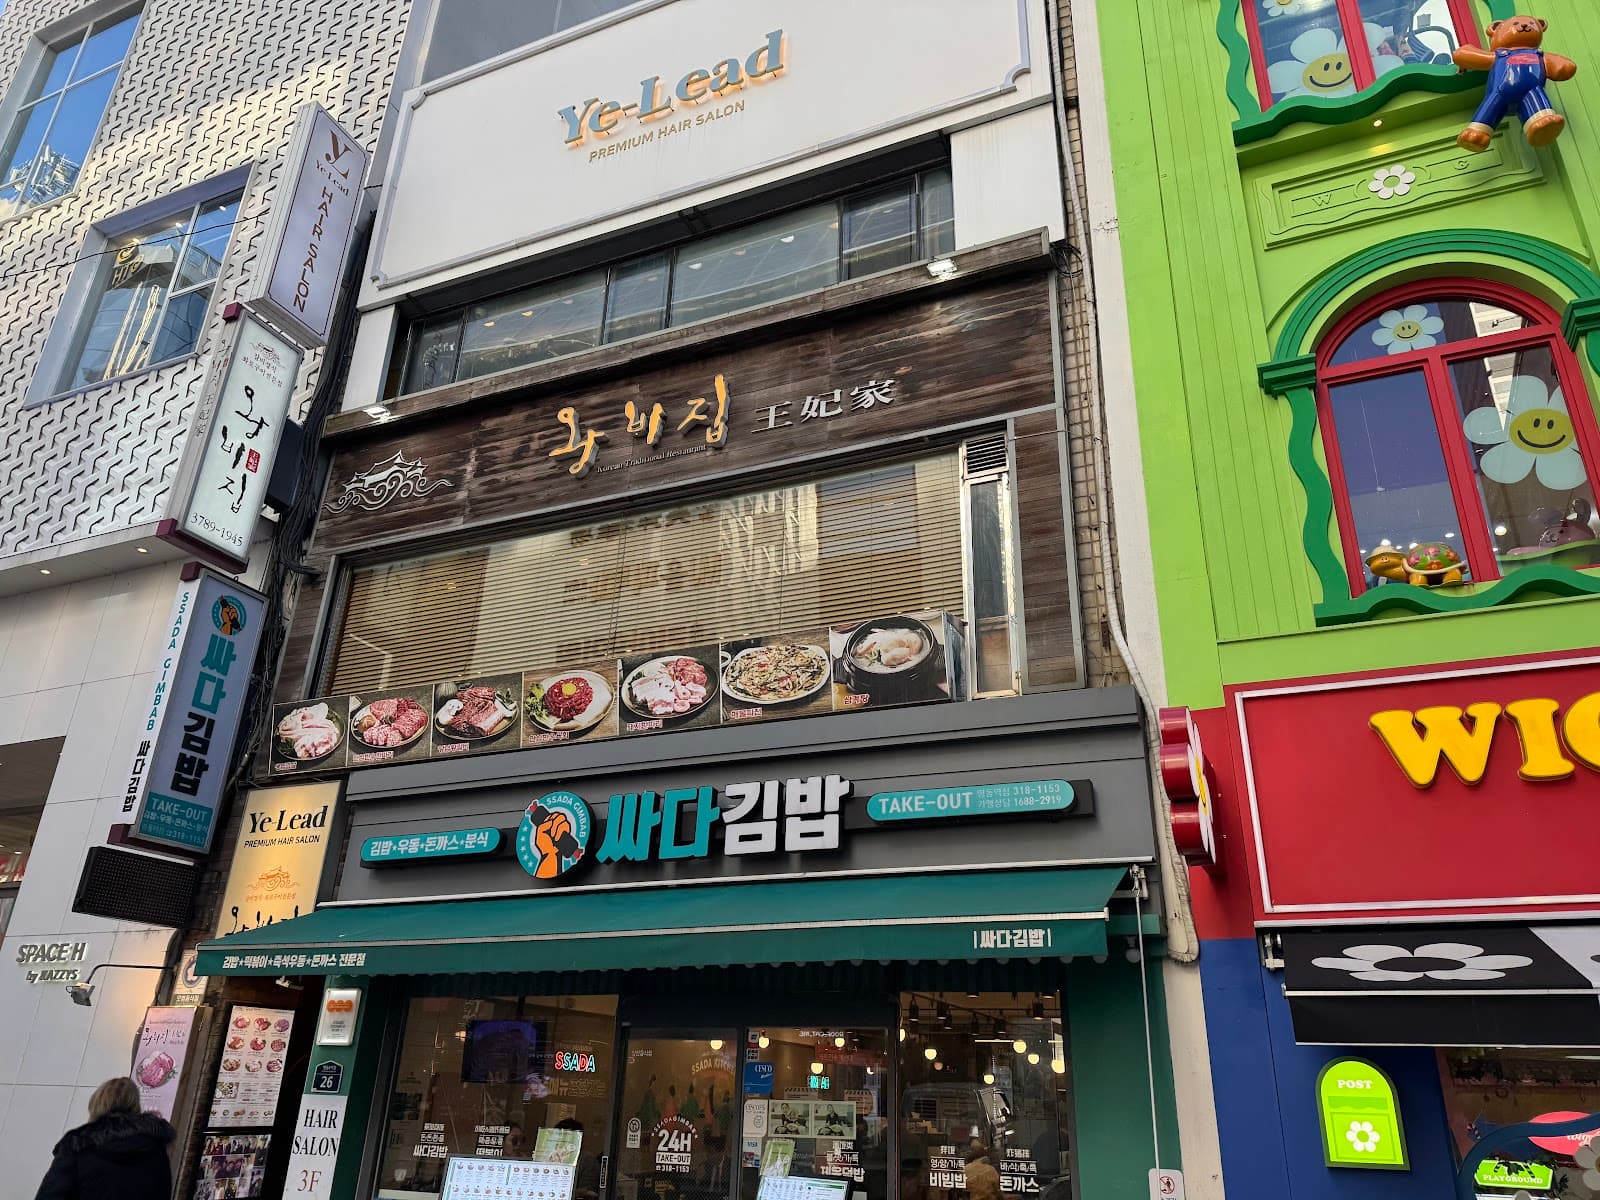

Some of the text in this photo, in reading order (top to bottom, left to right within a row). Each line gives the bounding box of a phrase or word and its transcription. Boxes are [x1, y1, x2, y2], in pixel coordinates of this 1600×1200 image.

[558, 29, 783, 144] Ye-Lead
[589, 100, 745, 162] PREMIUM HAIR SALON
[293, 186, 333, 312] HAIR SALON
[751, 379, 896, 433] 王妃家
[549, 374, 729, 477] 왕비집
[666, 444, 707, 458] Restaurant
[190, 512, 243, 547] 3789-1945
[146, 592, 190, 731] SSADA GIMBAB
[843, 693, 870, 705] 삼계탕
[170, 634, 237, 797] 싸다김밥
[122, 740, 151, 812] 싸다김밥
[1013, 784, 1060, 795] 318-1153
[151, 798, 208, 822] TAKE-OUT
[879, 792, 973, 815] TAKE-OUT
[1014, 795, 1062, 806] 1688-2919
[250, 806, 329, 834] Ye-Lead
[547, 795, 587, 838] SSADA GIMBAB
[596, 775, 850, 864] 싸다김밥
[244, 834, 320, 848] PREMIUM HAIR SALON
[370, 835, 489, 857] 김밥 우동 돈까스 분식
[980, 928, 1045, 948] 싸다김밥
[16, 942, 87, 962] SPACE H
[223, 953, 366, 969] 김밥 떡볶이 즉석우동 돈까스 전문점
[26, 970, 38, 984] by
[554, 1051, 596, 1073] SSADA
[691, 1057, 713, 1074] SSADA
[319, 1075, 334, 1089] 26
[1337, 1079, 1373, 1090] POST
[304, 1109, 338, 1129] HAIR
[292, 1136, 339, 1157] SALON
[413, 1144, 449, 1158] 싸다김밥
[657, 1129, 692, 1152] 24H
[657, 1154, 690, 1163] TAKE-OUT
[297, 1170, 322, 1193] 3F
[929, 1172, 967, 1189] 비빔밥
[1000, 1176, 1040, 1193] 돈까스
